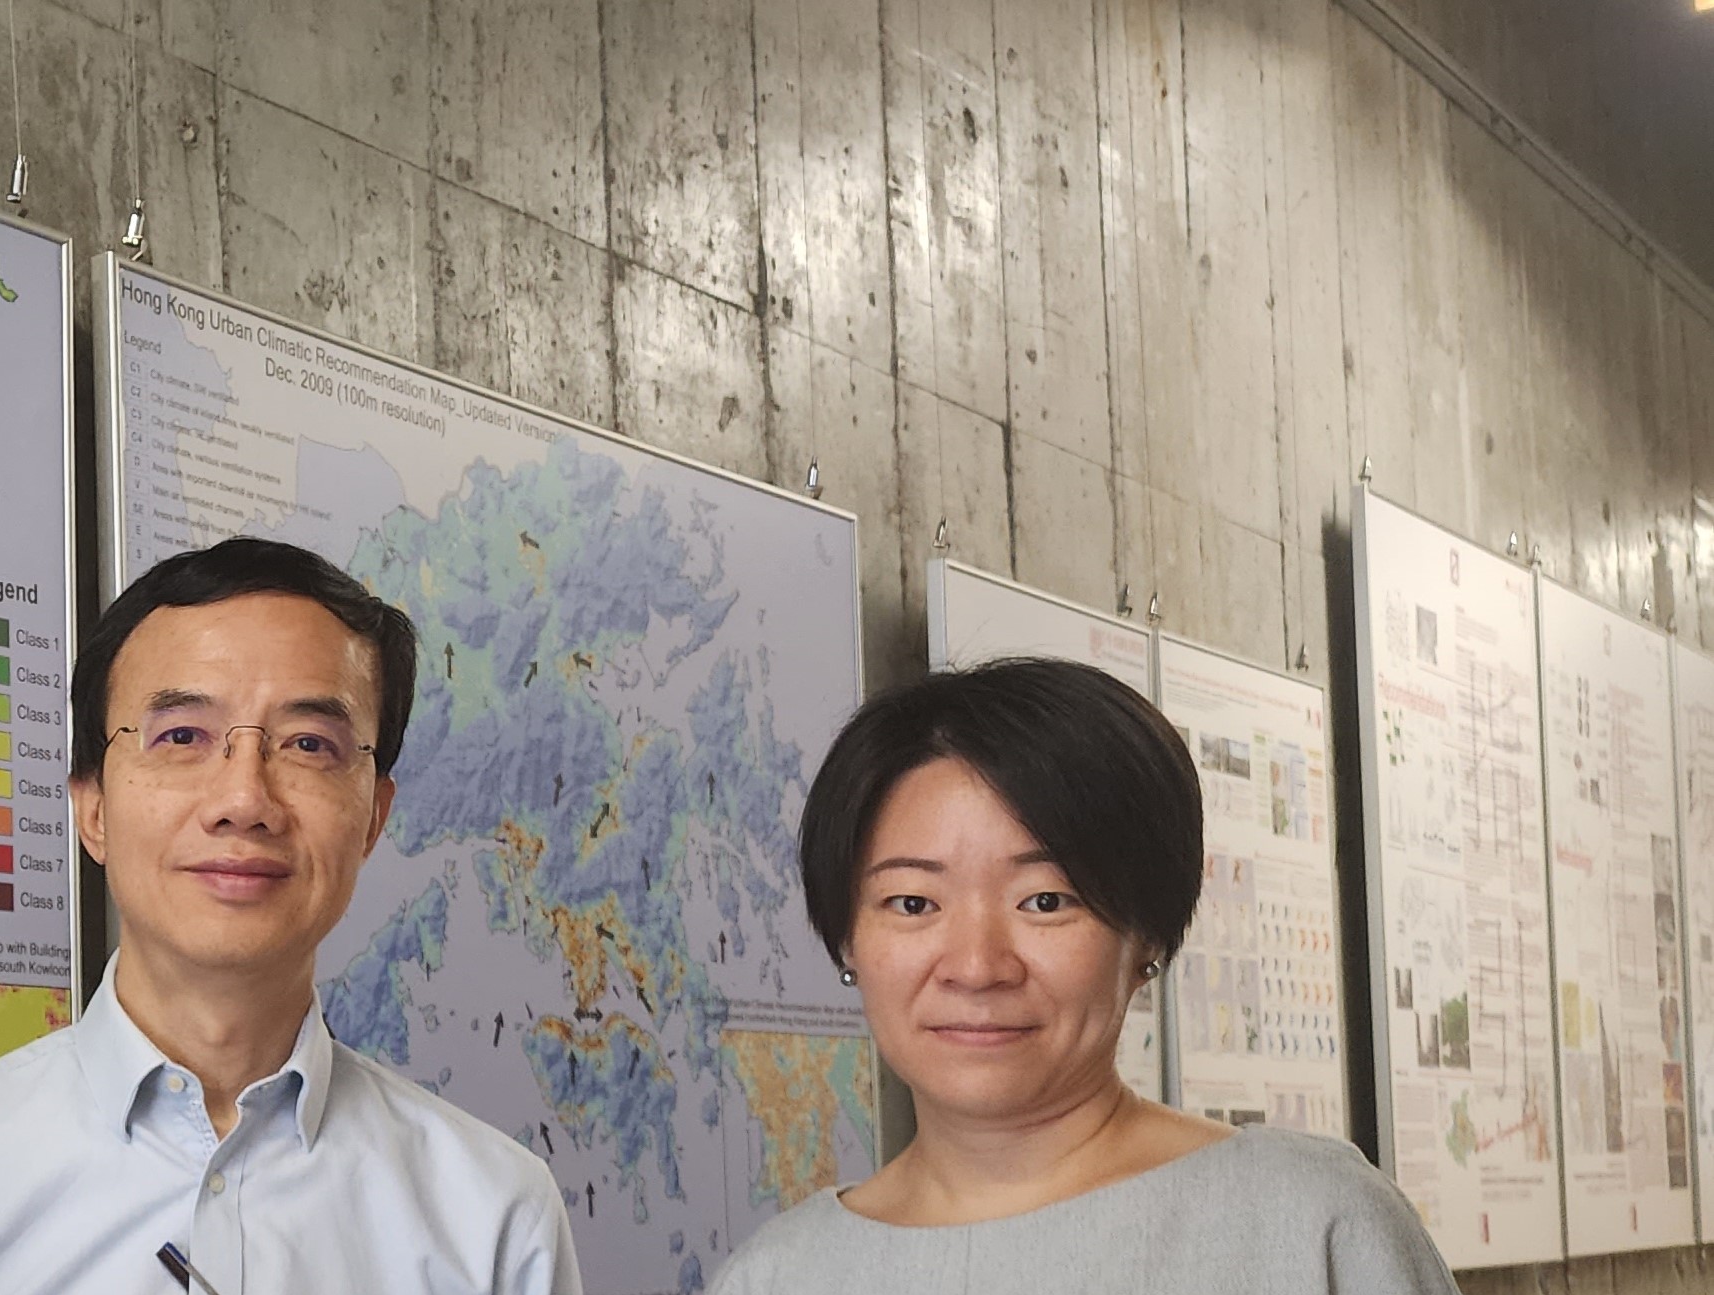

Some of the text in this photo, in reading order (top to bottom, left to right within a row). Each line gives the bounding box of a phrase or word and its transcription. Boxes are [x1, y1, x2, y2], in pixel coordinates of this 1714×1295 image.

[121, 277, 162, 315] Hong
[167, 294, 204, 330] Kong
[210, 309, 252, 342] Urban
[257, 326, 312, 362] Climatic
[316, 346, 426, 401] Recommendation
[124, 329, 162, 355] Legend
[266, 357, 446, 438] Dec. 2009 (100m resolution)
[16, 629, 59, 651] Class 1
[17, 667, 61, 689] Class 2
[17, 704, 61, 725] Class 3
[18, 742, 62, 761] Class 4
[19, 779, 62, 799] Class 5
[19, 816, 63, 837] Class 6
[20, 854, 64, 872] Class 7
[20, 892, 64, 911] Class 8
[7, 940, 27, 955] with
